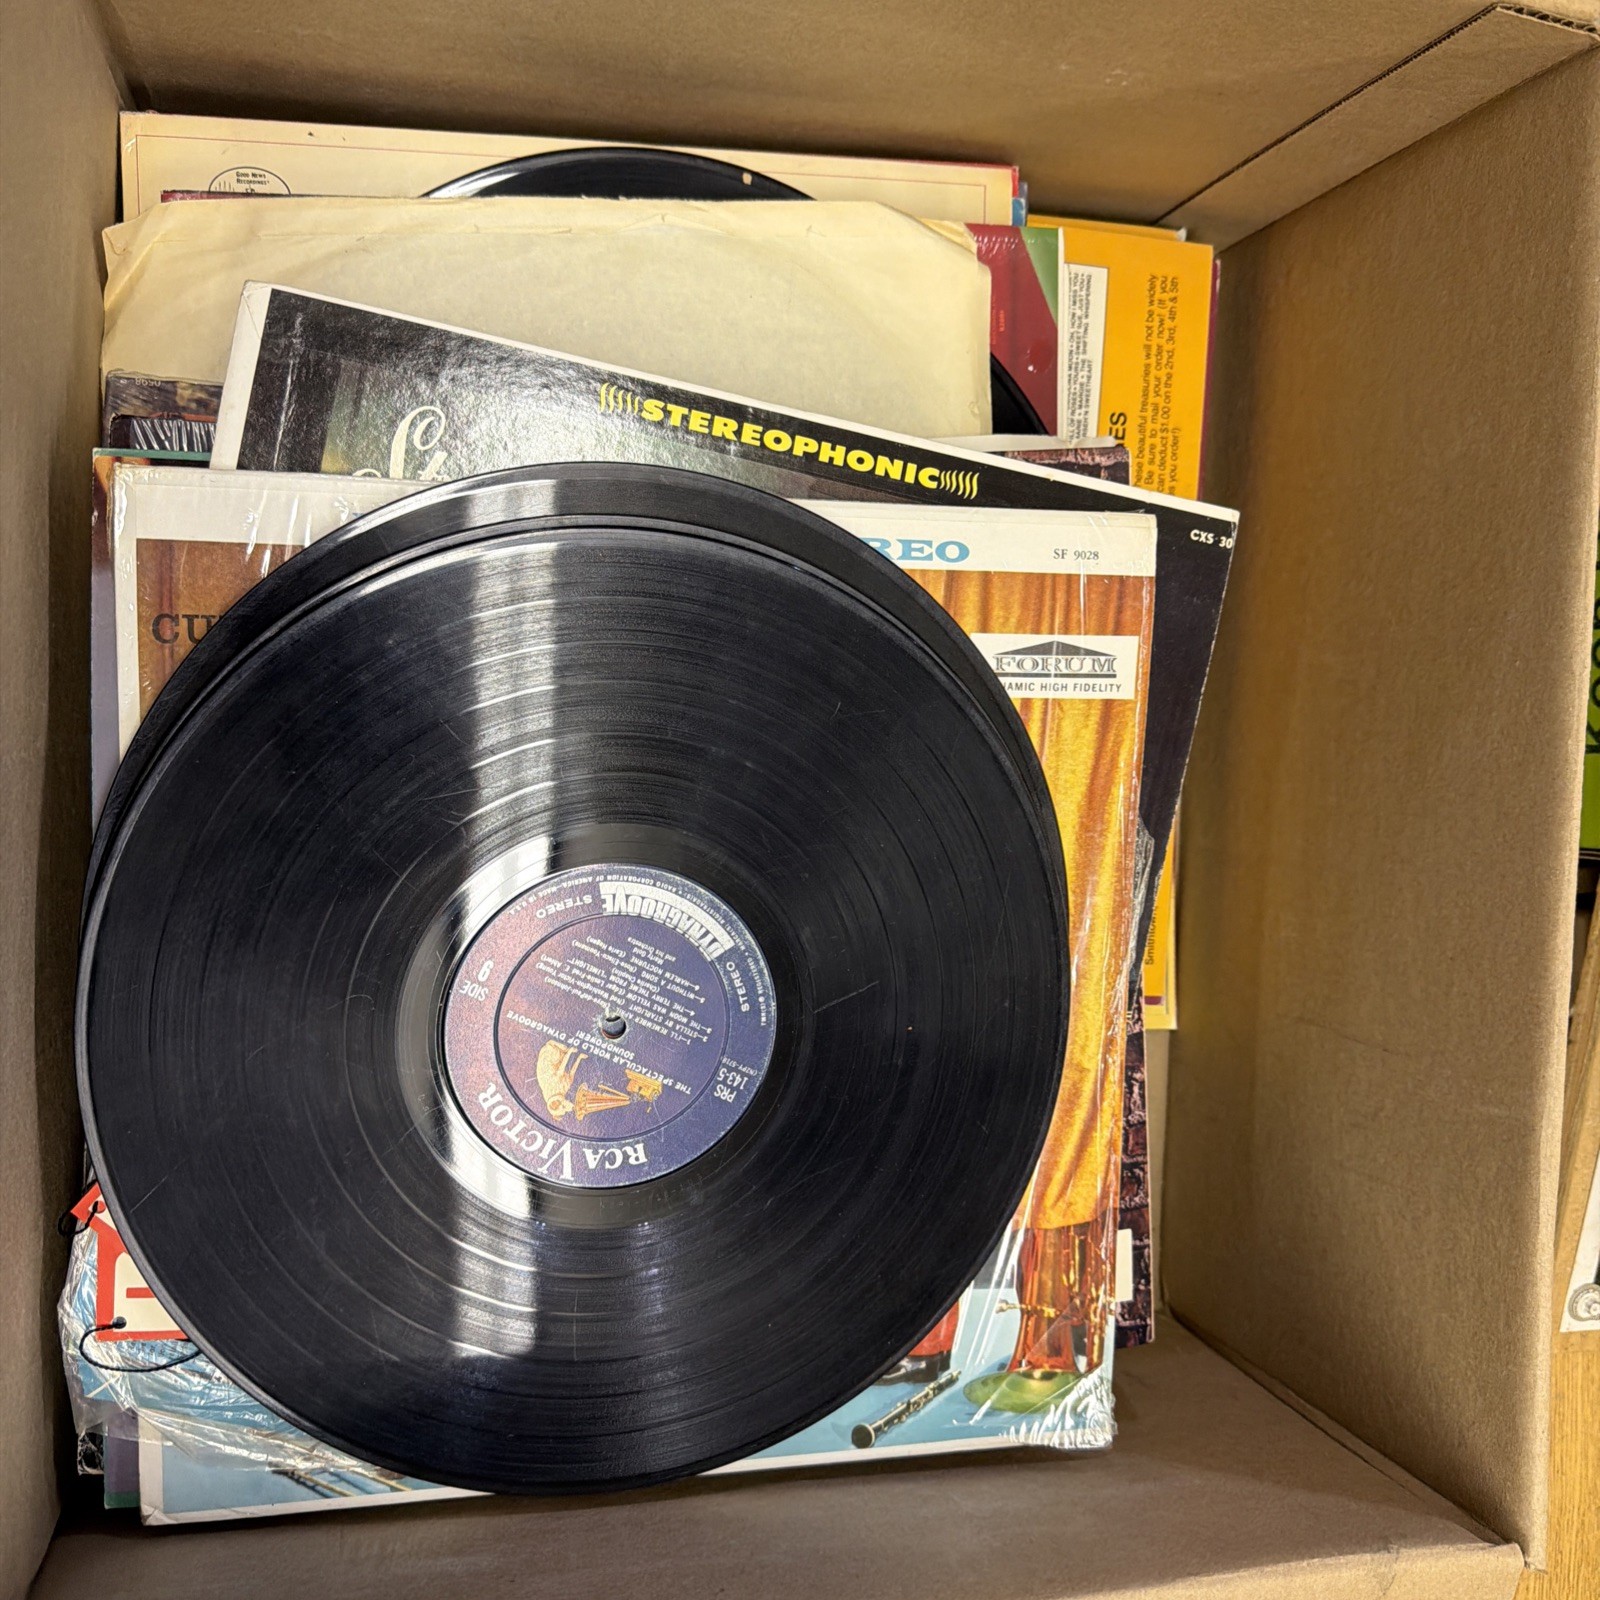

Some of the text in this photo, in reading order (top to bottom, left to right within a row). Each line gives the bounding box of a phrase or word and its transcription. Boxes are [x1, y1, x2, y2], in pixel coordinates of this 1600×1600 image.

[1146, 274, 1158, 306] widely
[1169, 276, 1179, 293] 5th
[1145, 310, 1154, 322] be
[1167, 306, 1176, 322] 4th
[1144, 325, 1153, 341] not
[1166, 325, 1177, 345] 3rd,
[1142, 344, 1151, 360] will
[1164, 347, 1175, 369] 2nd,
[1084, 359, 1092, 408] SWEETHEART
[1139, 363, 1150, 412] treasuries
[1144, 275, 1169, 484] Be sure to mail your order now! (If you
[1163, 372, 1172, 388] the
[1163, 391, 1171, 404] on
[1110, 411, 1127, 444] ES
[1160, 406, 1170, 433] $1.00
[641, 399, 941, 489] STEREOPHONIC
[1135, 415, 1146, 458] beautiful
[1169, 427, 1180, 461] order!)
[1157, 436, 1167, 470] deduct
[1169, 464, 1177, 482] you
[1190, 529, 1233, 549] CXS 30
[1053, 549, 1099, 561] SF 9028
[152, 613, 218, 644] CU
[994, 656, 1117, 672] FORUM
[1040, 682, 1068, 692] HIGH
[1073, 683, 1122, 693] FIDELITY
[607, 874, 655, 886] CORPORATION
[656, 880, 678, 893] RADIO
[536, 895, 592, 919] STEREO
[601, 885, 727, 961] DYNAGROOVE
[626, 936, 676, 962] and his Orchestra
[632, 946, 664, 964] Marty Gold
[478, 960, 494, 982] 9
[534, 961, 557, 976] Young)
[629, 955, 663, 974] NOCTURNE
[609, 974, 627, 986] FROM
[610, 966, 660, 993] (Charlie Chaplin)
[640, 970, 658, 983] SONG
[459, 980, 488, 1001] SIDE
[628, 982, 650, 996] THEME
[726, 961, 750, 1012] STEREO
[625, 991, 651, 1007] YELLOW
[650, 992, 671, 1005] TERRY
[628, 1002, 663, 1022] STARLIGHT
[652, 1003, 667, 1014] WAS
[668, 1010, 688, 1023] MOON
[634, 1015, 668, 1034] REMEMBER
[664, 1018, 673, 1027] BY
[506, 1009, 692, 1094] THE SPECTACULAR WORLD OF DYNAGROOVE
[575, 1029, 634, 1059] SOUNDPOWER!
[717, 1068, 748, 1090] 143-5
[714, 1084, 737, 1103] PRS
[478, 1082, 648, 1181] RCA VICTOR
